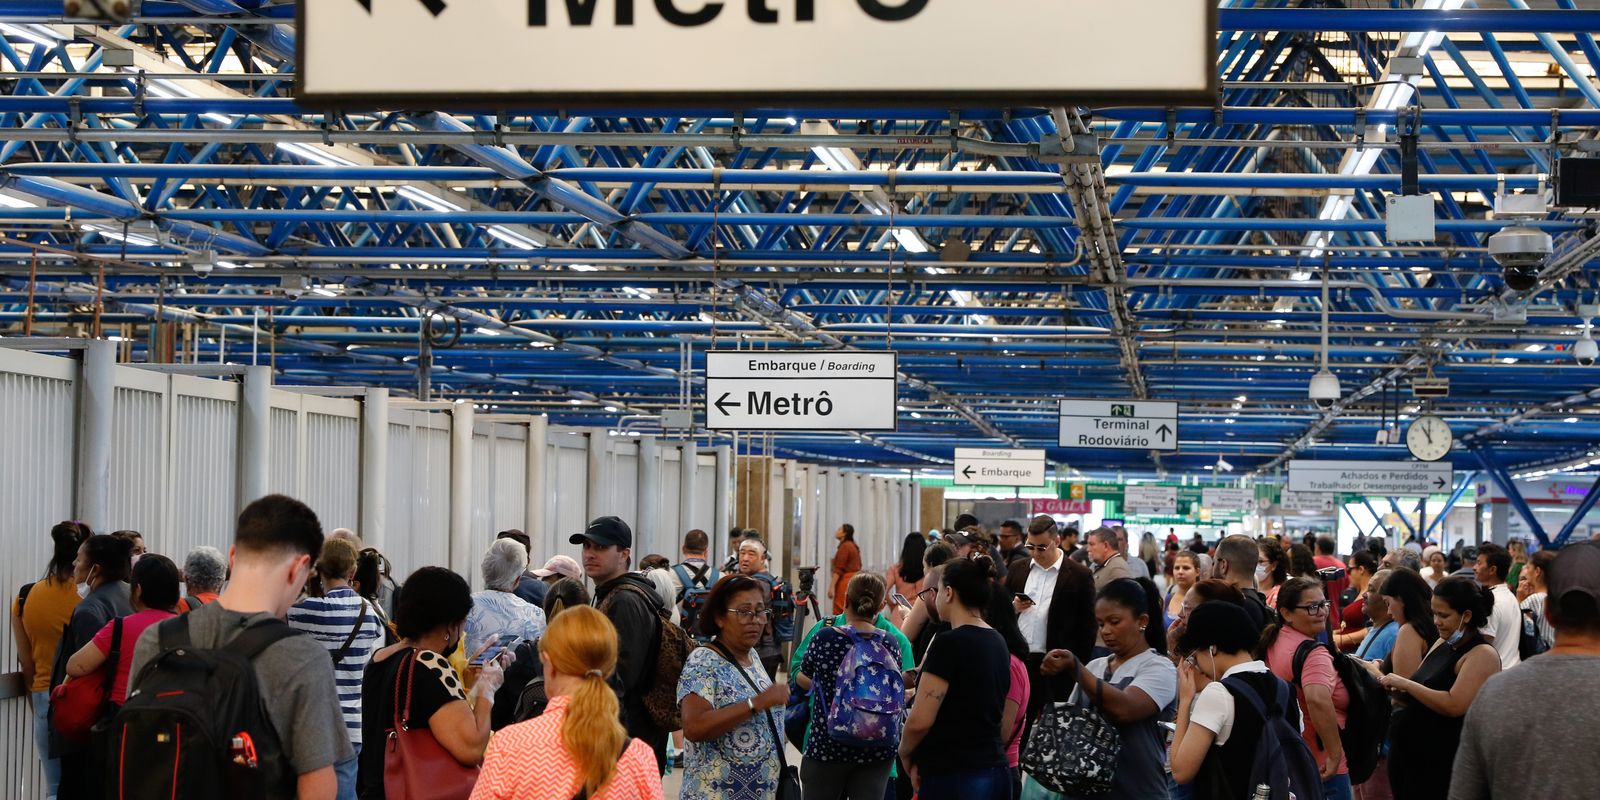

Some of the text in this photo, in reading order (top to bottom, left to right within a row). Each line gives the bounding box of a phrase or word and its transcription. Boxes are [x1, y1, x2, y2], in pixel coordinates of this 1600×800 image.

[748, 359, 876, 373] Embarque / Boarding
[747, 390, 834, 416] Metrô
[1093, 418, 1150, 430] Terminal
[1078, 434, 1149, 447] Rodoviário
[982, 450, 1013, 458] Boarding
[981, 467, 1032, 478] Embarque
[1340, 471, 1379, 480] Achados
[1389, 472, 1429, 481] Perdidos
[1309, 481, 1429, 492] Trabalhador Desempregado
